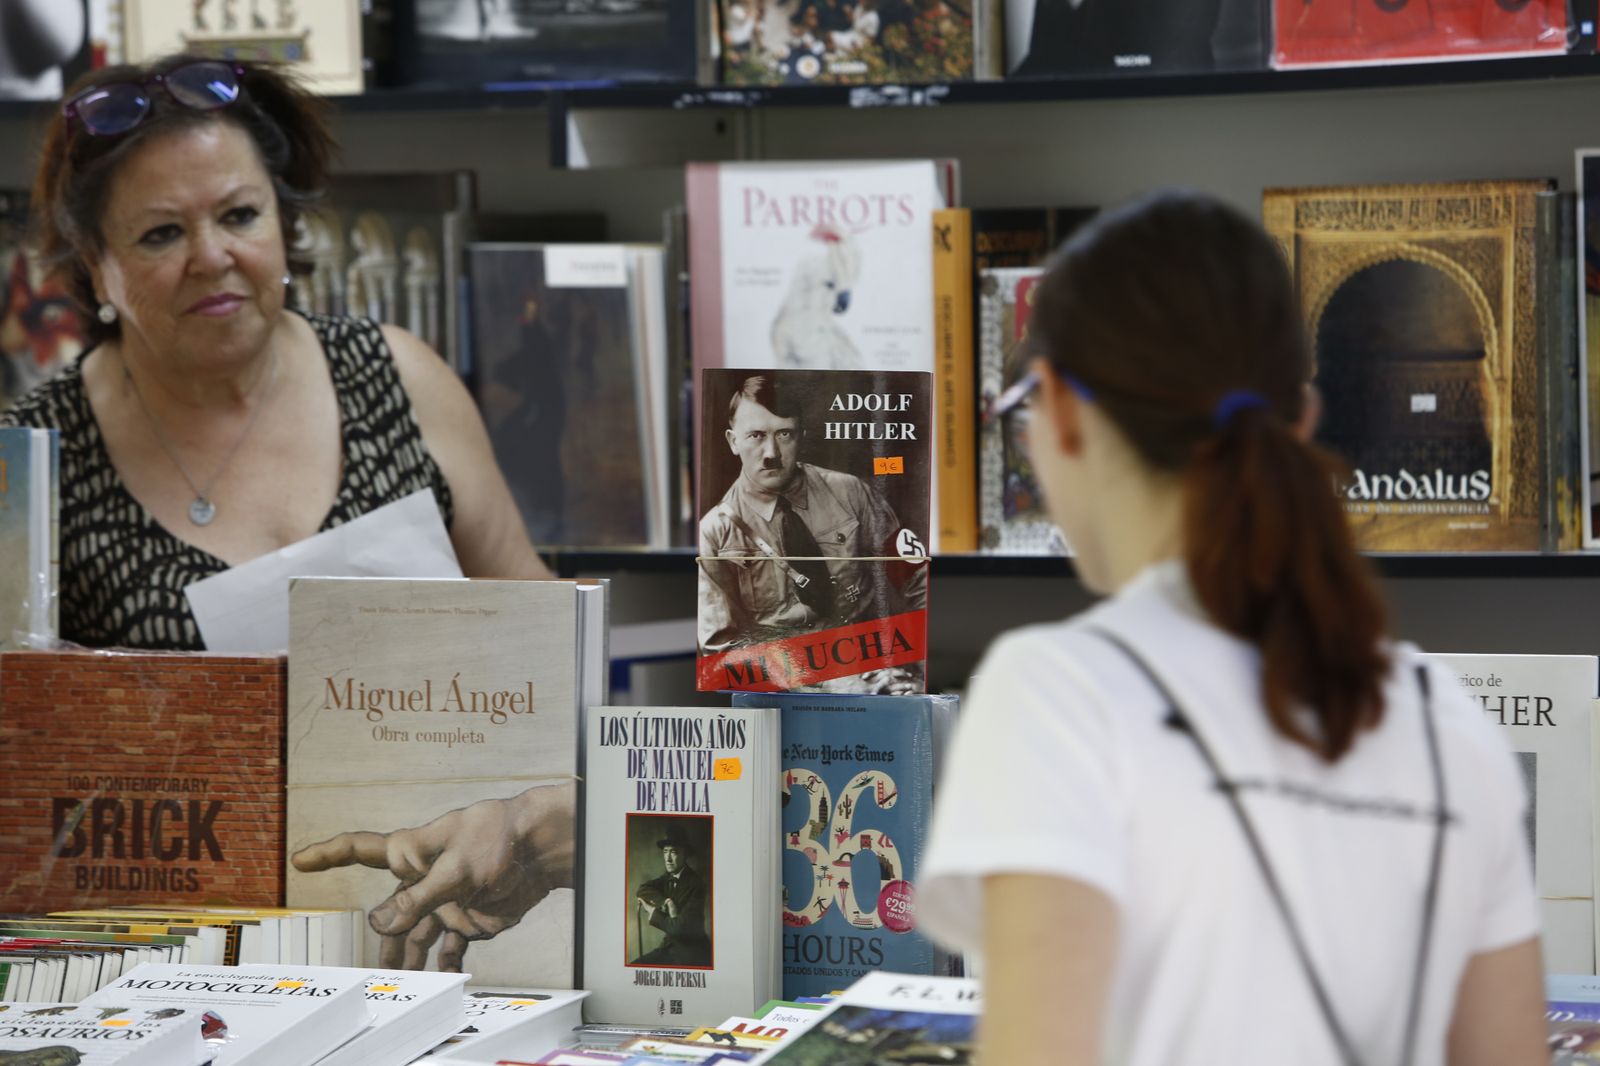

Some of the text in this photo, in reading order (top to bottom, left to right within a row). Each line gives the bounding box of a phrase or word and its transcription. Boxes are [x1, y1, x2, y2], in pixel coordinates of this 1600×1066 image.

[829, 393, 913, 411] ADOLF
[823, 422, 917, 440] HITLER
[1487, 673, 1503, 687] de
[323, 672, 536, 724] Miguel Ángel
[371, 725, 486, 748] Obra completa
[600, 711, 746, 750] LOS ÚLTIMOS AÑOS
[627, 748, 716, 781] DE MANUEL
[790, 743, 819, 761] New
[821, 744, 853, 766] York
[855, 743, 896, 763] Times
[67, 775, 210, 793] 100 CONTEMPORARY
[636, 780, 711, 813] DE FALLA
[52, 797, 226, 862] BRICK
[74, 865, 200, 893] BUILDINGS
[783, 934, 885, 967] HOURS
[633, 969, 707, 988] JORGE DE PERSIA
[0, 1026, 152, 1041] OSAURIOS
